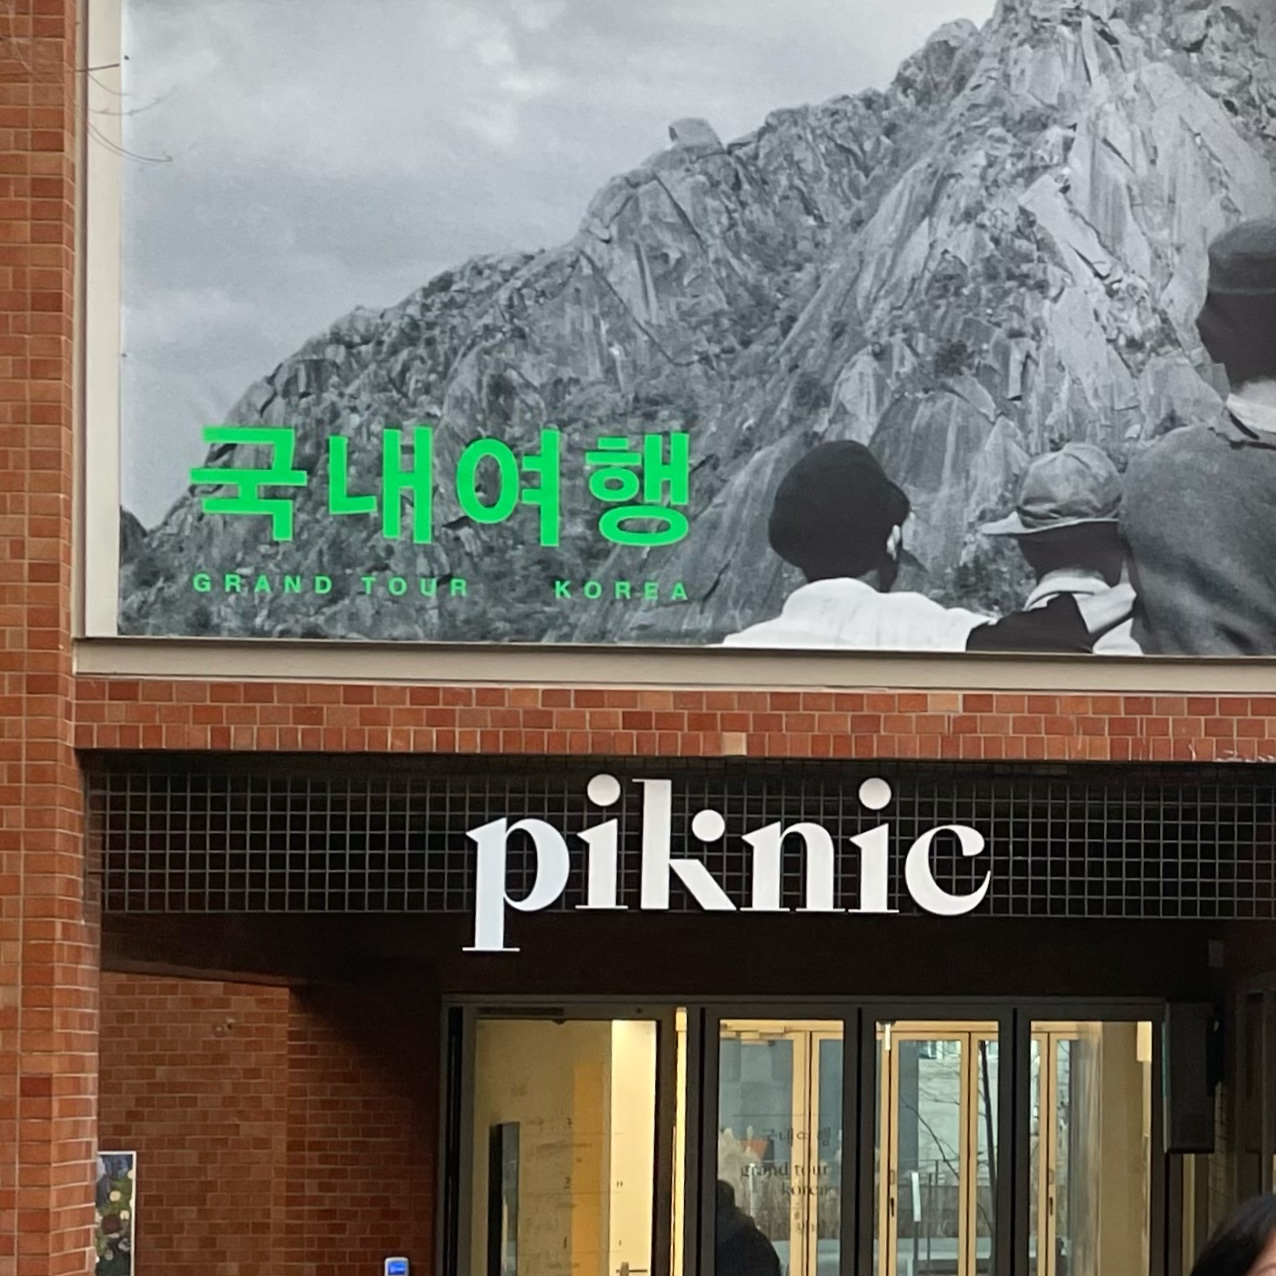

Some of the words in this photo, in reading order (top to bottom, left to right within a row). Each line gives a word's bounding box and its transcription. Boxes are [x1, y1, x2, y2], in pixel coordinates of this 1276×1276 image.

[188, 425, 690, 547] 국내여행
[192, 573, 333, 595] GRAND
[361, 576, 469, 598] TOUR
[554, 579, 688, 601] KOREA
[462, 773, 992, 952] piknic
